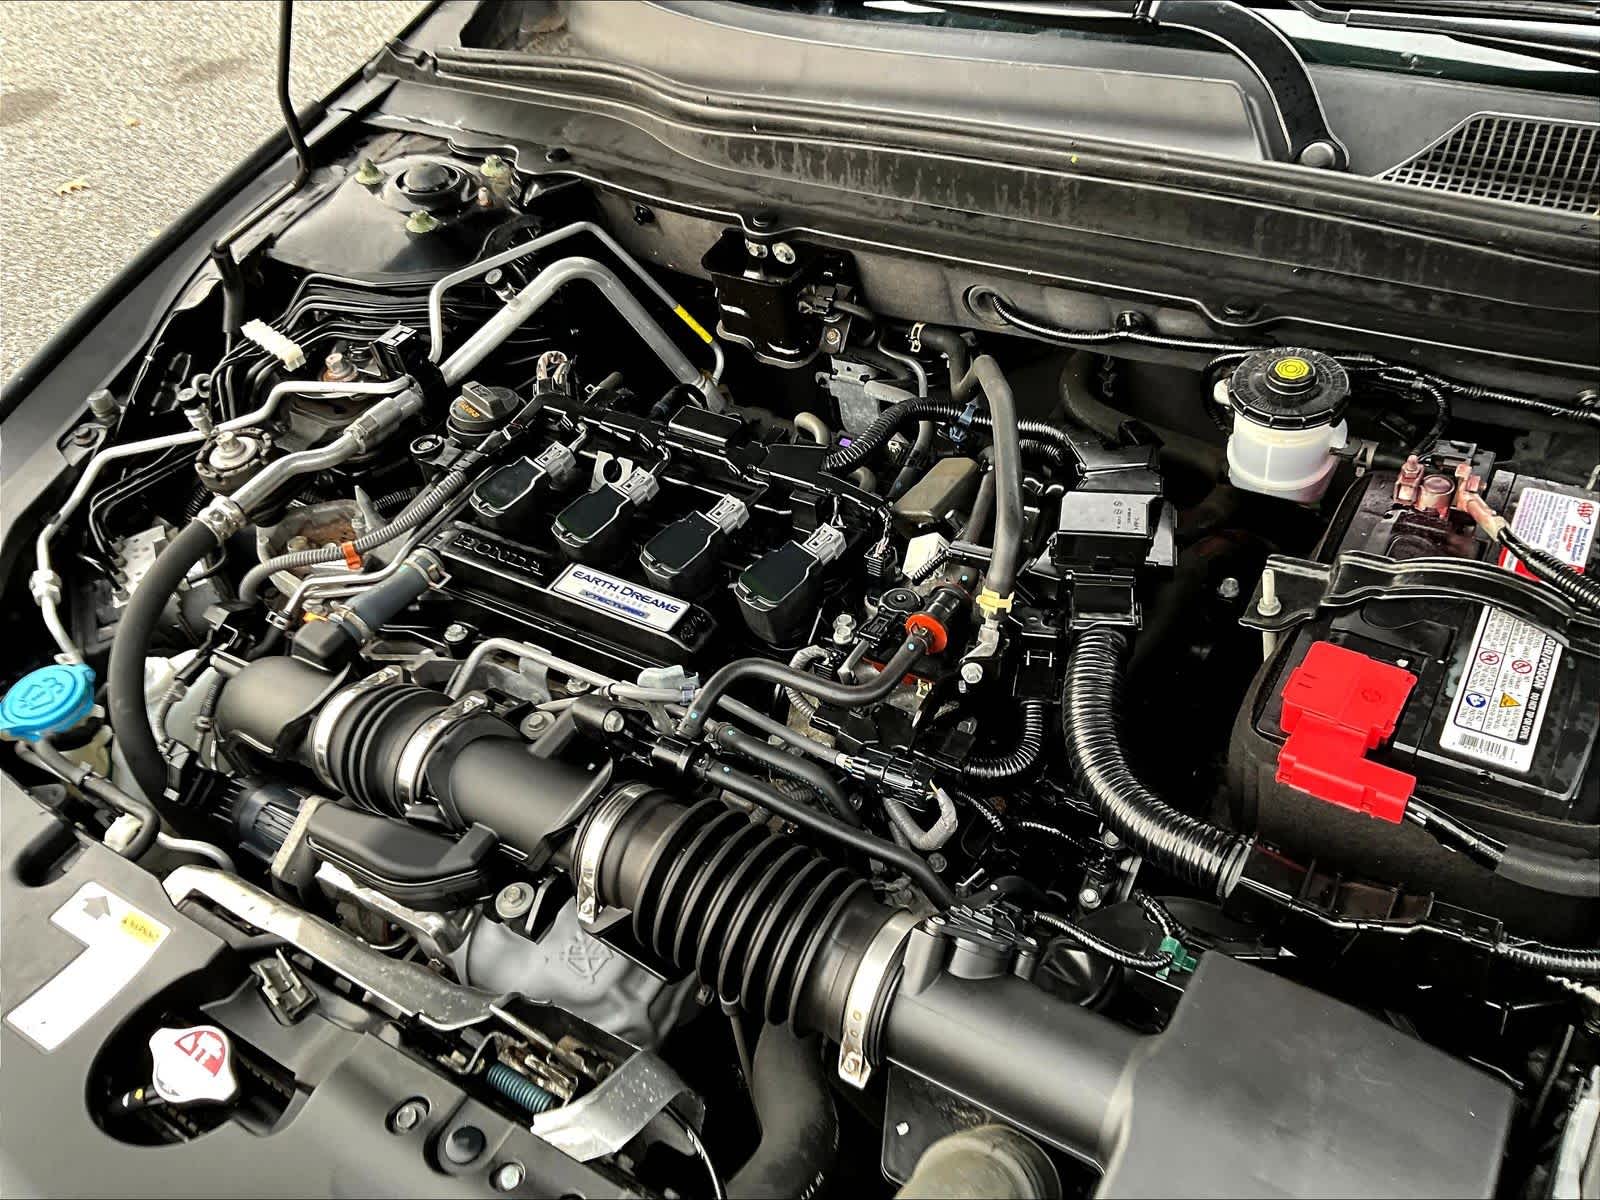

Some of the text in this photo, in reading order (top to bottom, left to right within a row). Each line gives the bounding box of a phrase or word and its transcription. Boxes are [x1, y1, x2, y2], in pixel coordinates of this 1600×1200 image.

[453, 533, 543, 576] HONDA
[572, 570, 681, 614] EARTH DREAMS
[1533, 636, 1557, 689] GER/POISON
